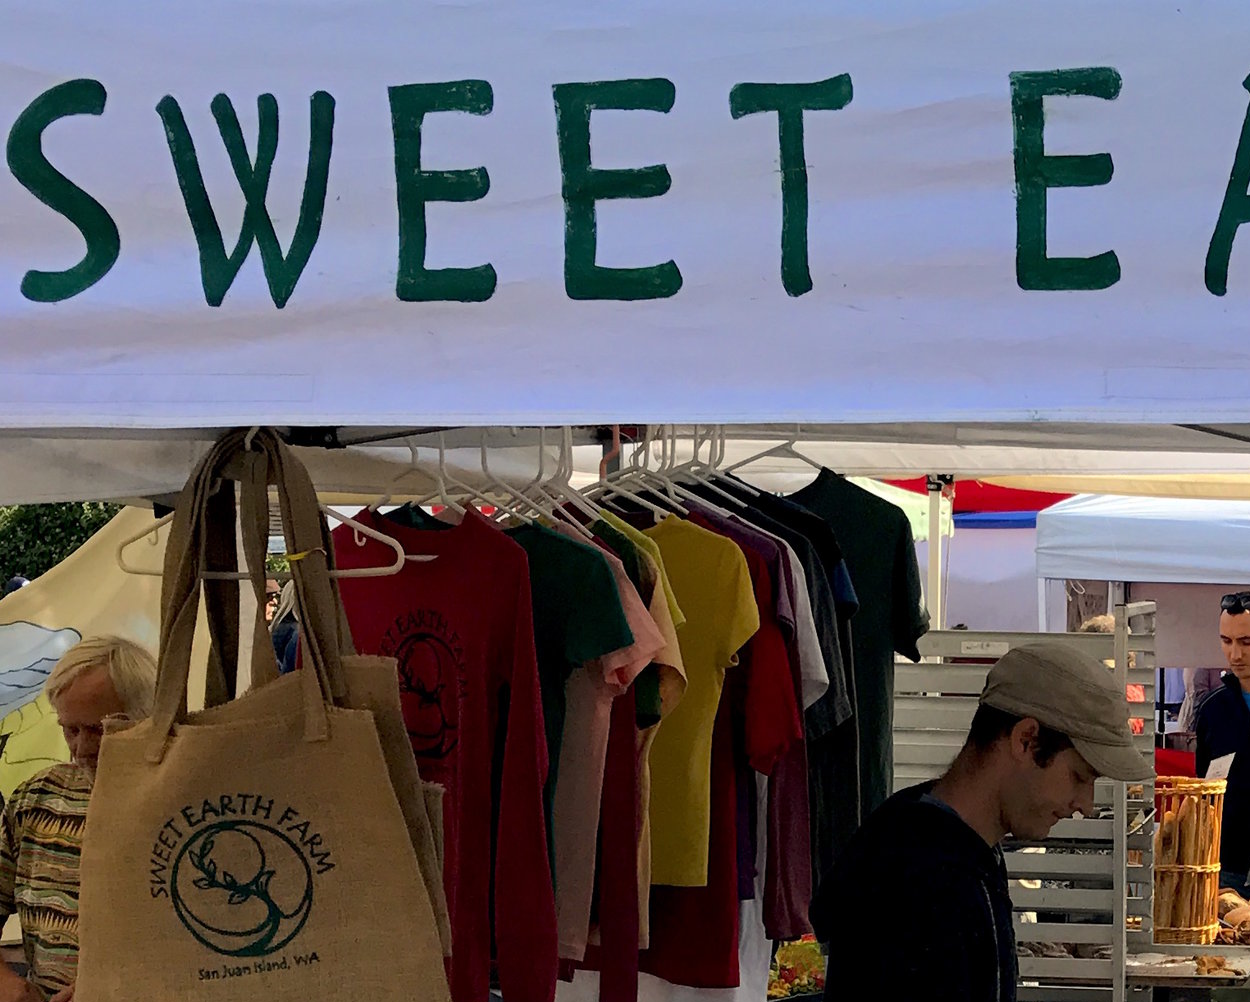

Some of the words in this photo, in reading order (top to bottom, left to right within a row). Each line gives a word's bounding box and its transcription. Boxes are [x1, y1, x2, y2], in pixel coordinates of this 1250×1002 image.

[6, 73, 854, 309] SWEET
[150, 817, 183, 899] SWEET
[180, 792, 275, 828] EARTH
[276, 806, 336, 875] FARM
[198, 967, 220, 982] San
[222, 964, 252, 979] Juan
[254, 956, 291, 974] Island,
[293, 952, 320, 966] WA
